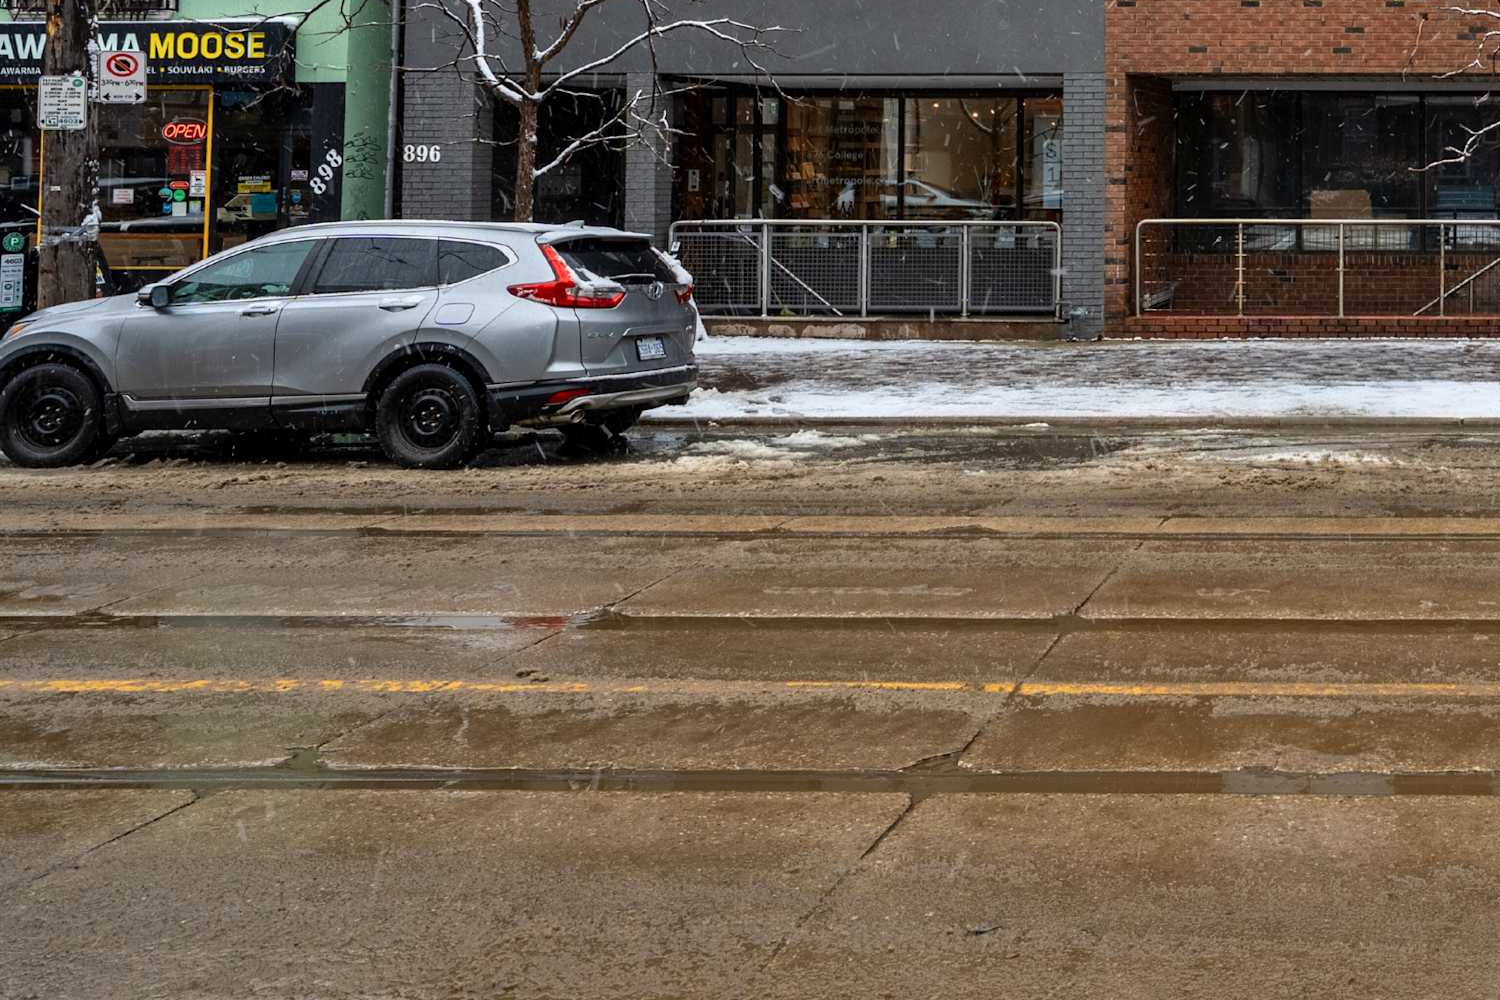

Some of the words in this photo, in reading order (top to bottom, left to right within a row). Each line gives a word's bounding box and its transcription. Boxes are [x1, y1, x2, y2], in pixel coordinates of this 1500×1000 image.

[0, 33, 140, 59] AWMA
[149, 32, 265, 59] MOOSE
[0, 66, 42, 74] AWARMA
[167, 65, 213, 74] SOUVLAKI
[224, 65, 265, 74] BURGERS
[164, 123, 207, 138] OPEN
[403, 144, 440, 162] 896
[309, 148, 343, 194] 898
